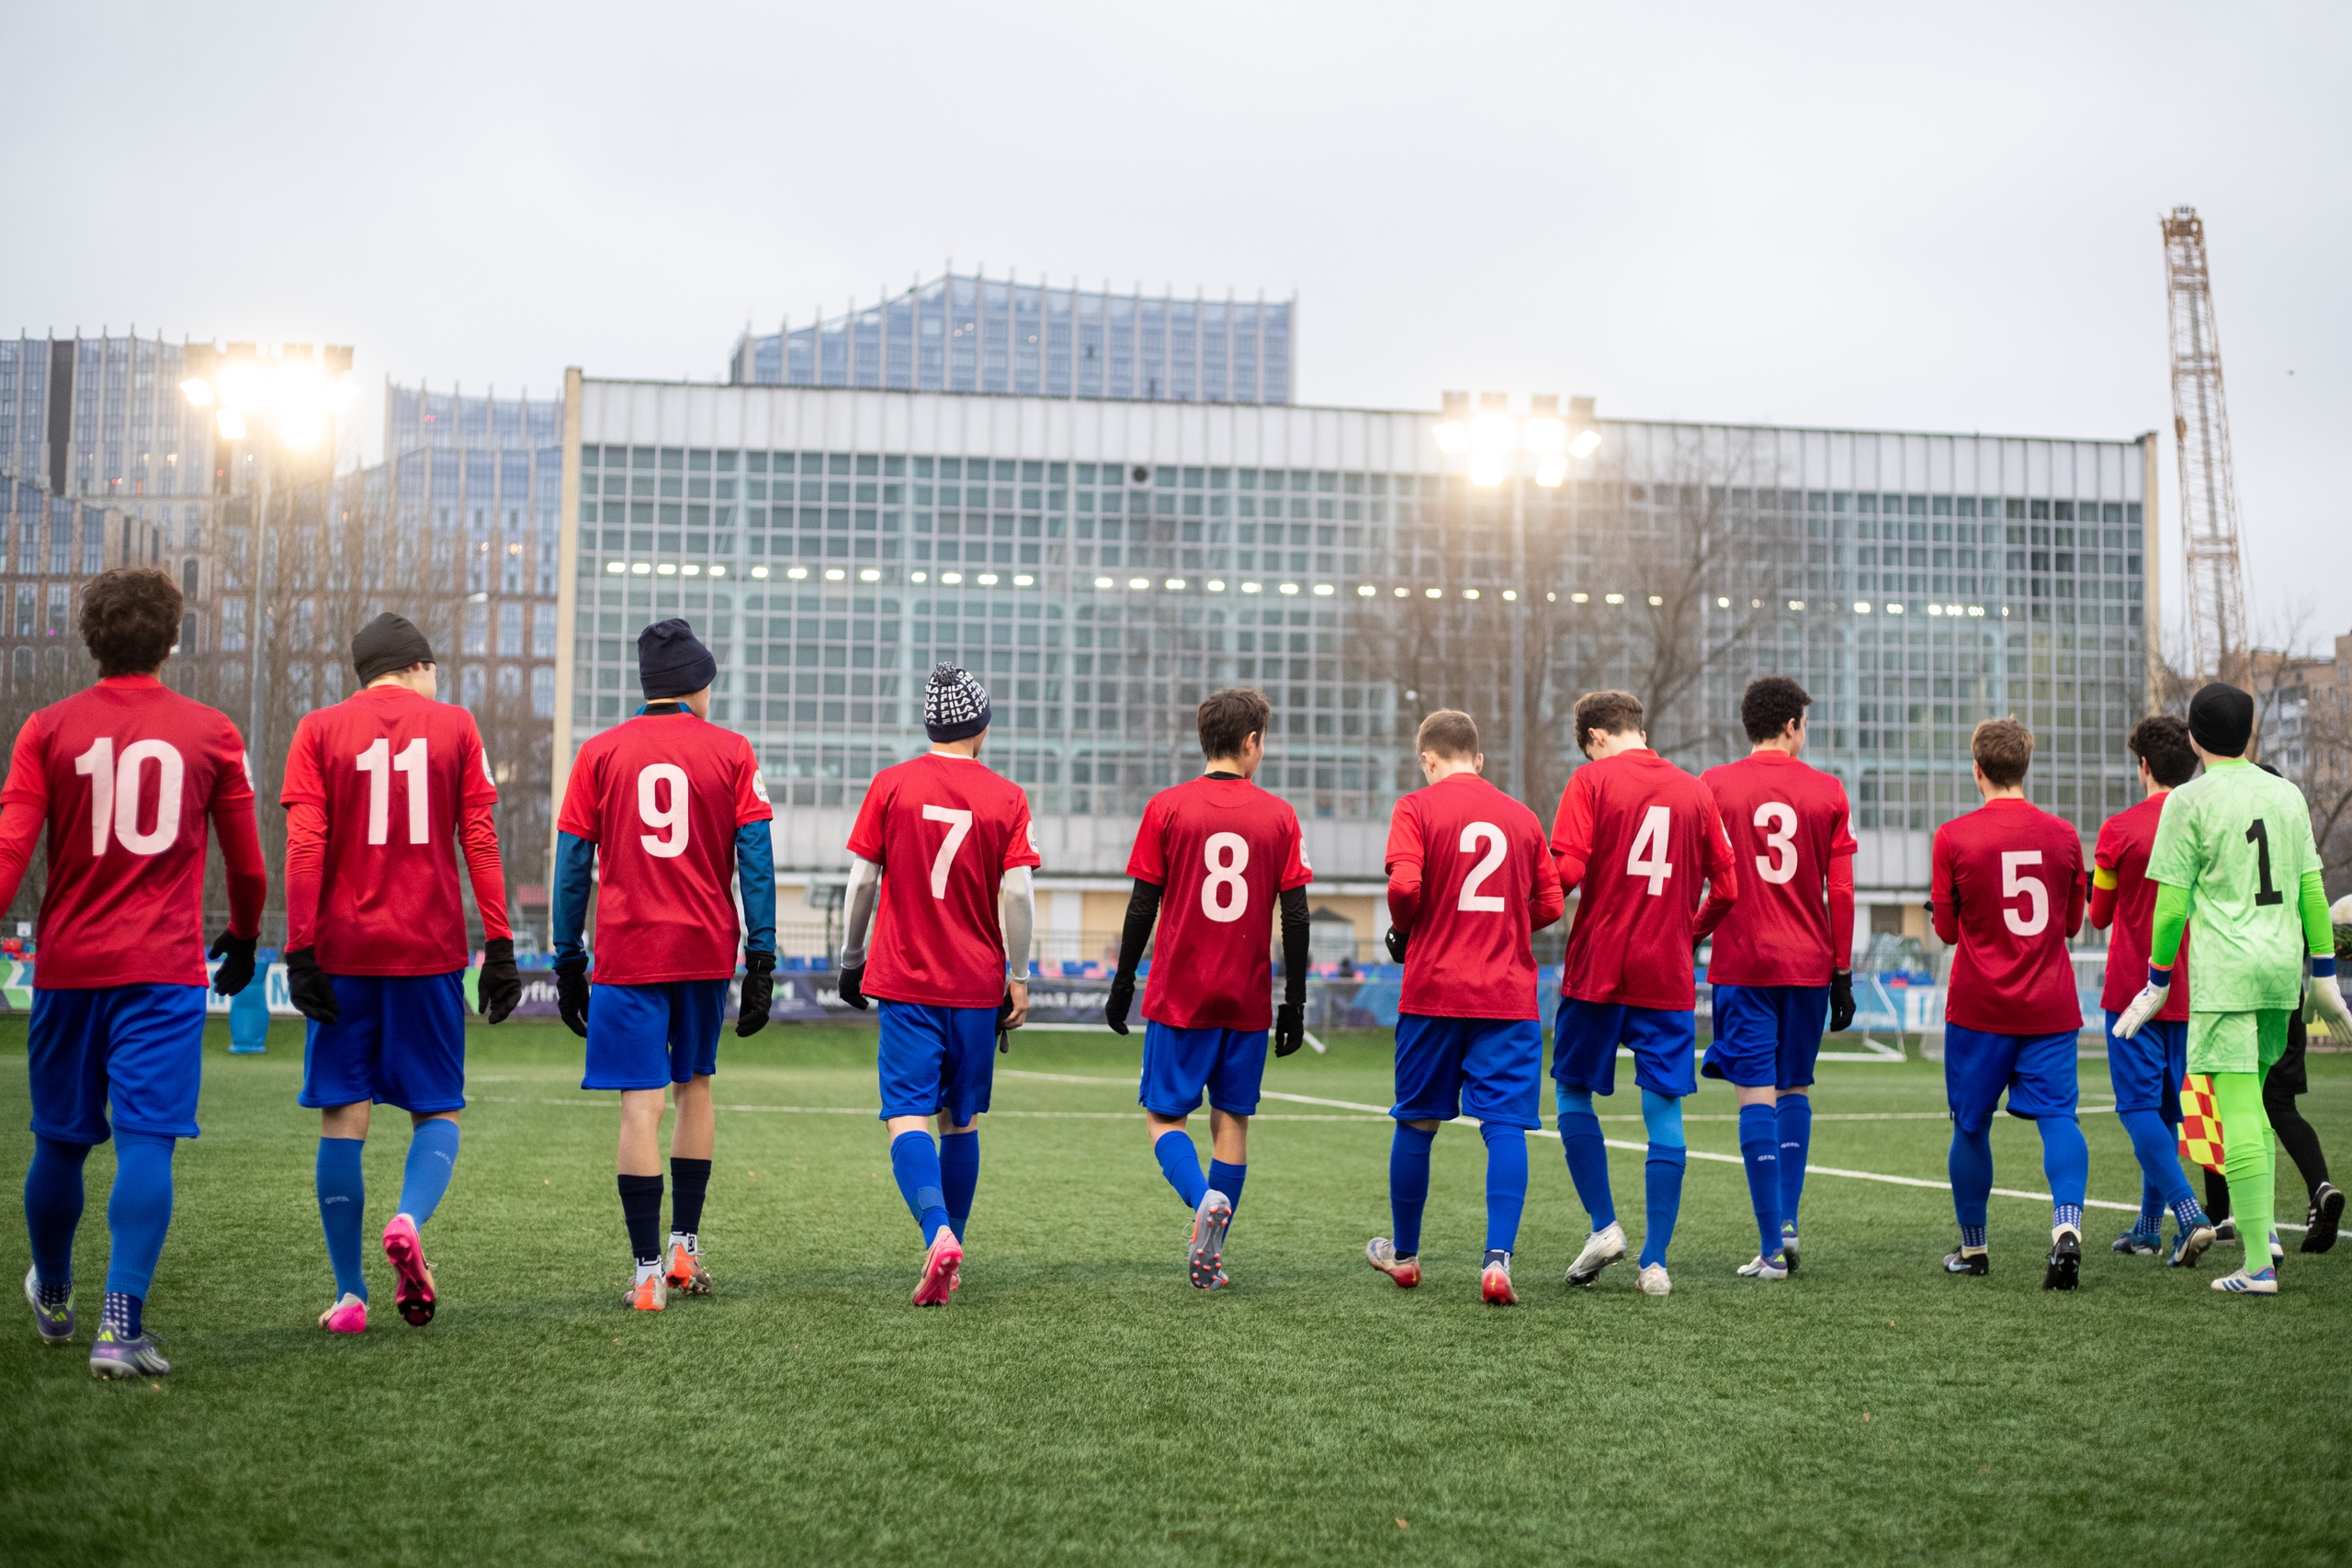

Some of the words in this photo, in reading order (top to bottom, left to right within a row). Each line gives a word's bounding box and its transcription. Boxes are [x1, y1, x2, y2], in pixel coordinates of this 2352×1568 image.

[941, 684, 964, 694] FILA
[941, 690, 967, 702] FILA
[941, 697, 971, 711] FILA
[941, 705, 974, 718] FILA
[74, 737, 184, 856] 10
[356, 738, 429, 845] 11
[637, 763, 689, 858] 9
[922, 805, 973, 900] 7
[1201, 832, 1250, 923] 8
[1457, 820, 1508, 913] 2
[1626, 805, 1673, 897] 4
[1753, 802, 1798, 885] 3
[2245, 818, 2283, 907] 1
[2001, 851, 2049, 936] 5
